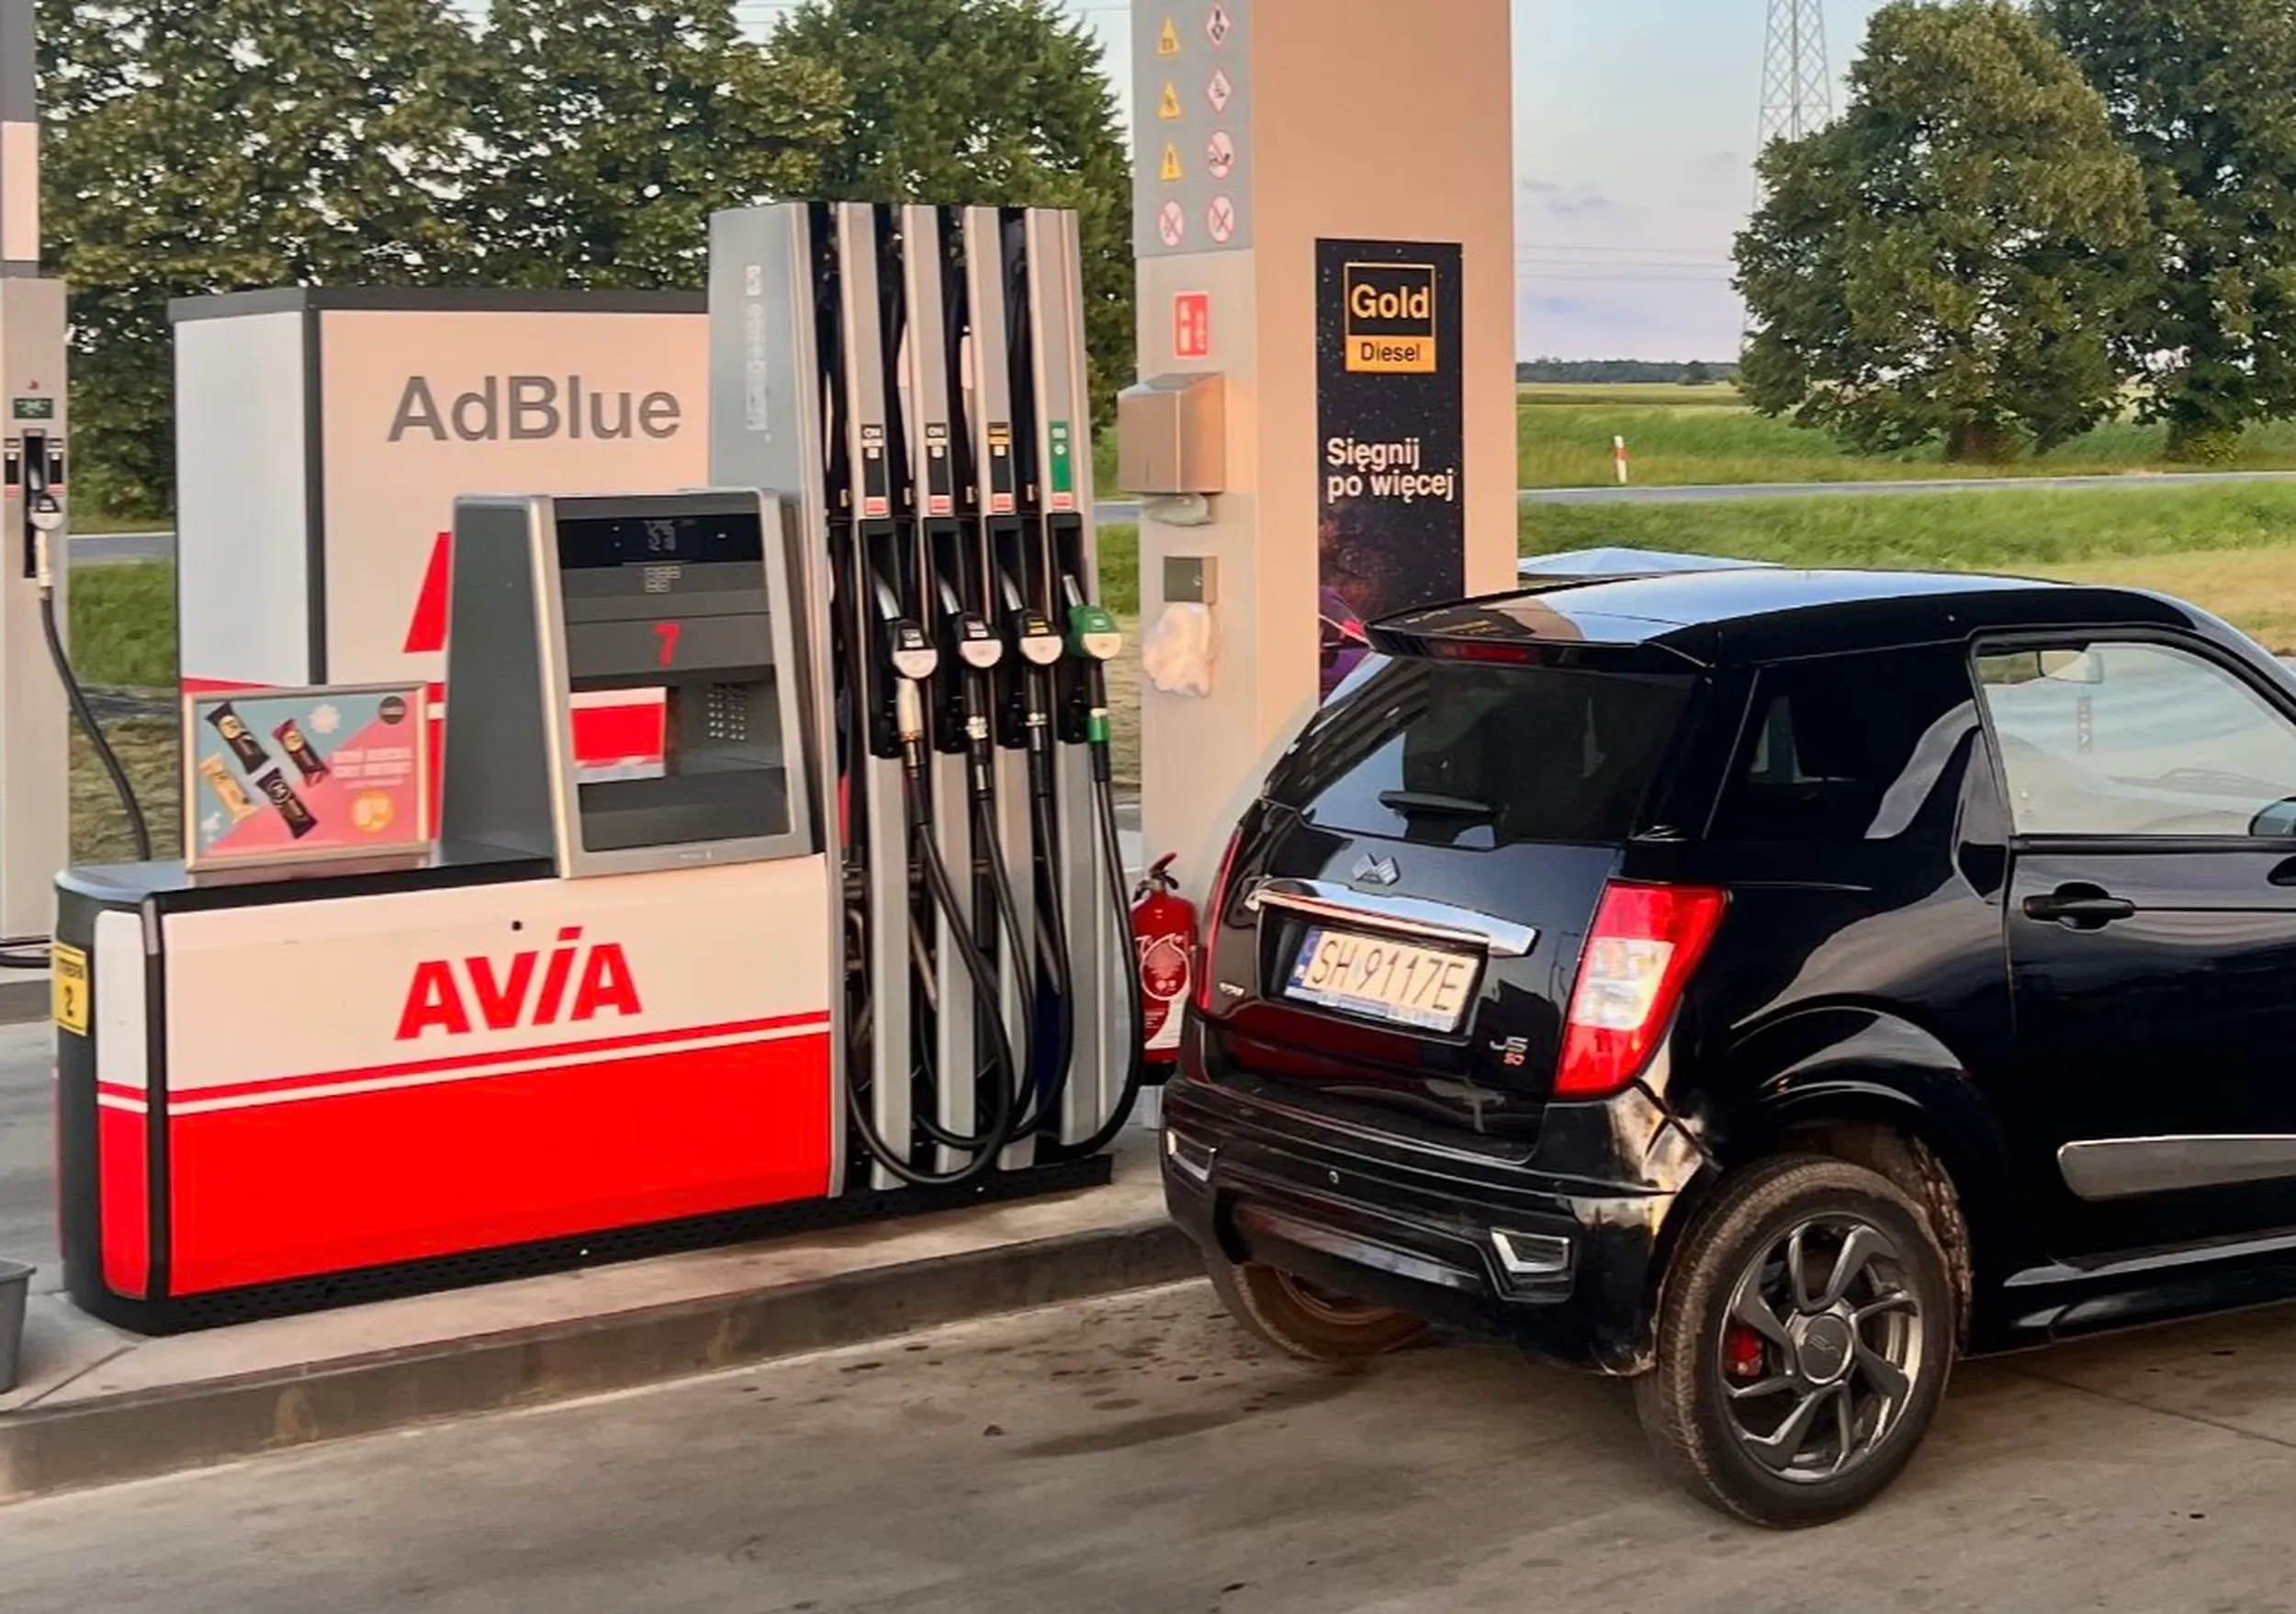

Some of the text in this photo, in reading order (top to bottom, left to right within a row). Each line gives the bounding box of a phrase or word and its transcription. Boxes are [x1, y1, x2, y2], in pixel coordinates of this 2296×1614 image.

[1351, 284, 1429, 319] Gold
[1361, 343, 1421, 362] Diesel
[388, 375, 681, 442] AdBlue
[1327, 437, 1421, 472] Sięgnij
[1327, 468, 1454, 503] po więcej
[654, 624, 681, 667] 7
[1311, 940, 1465, 1010] SH 9117E
